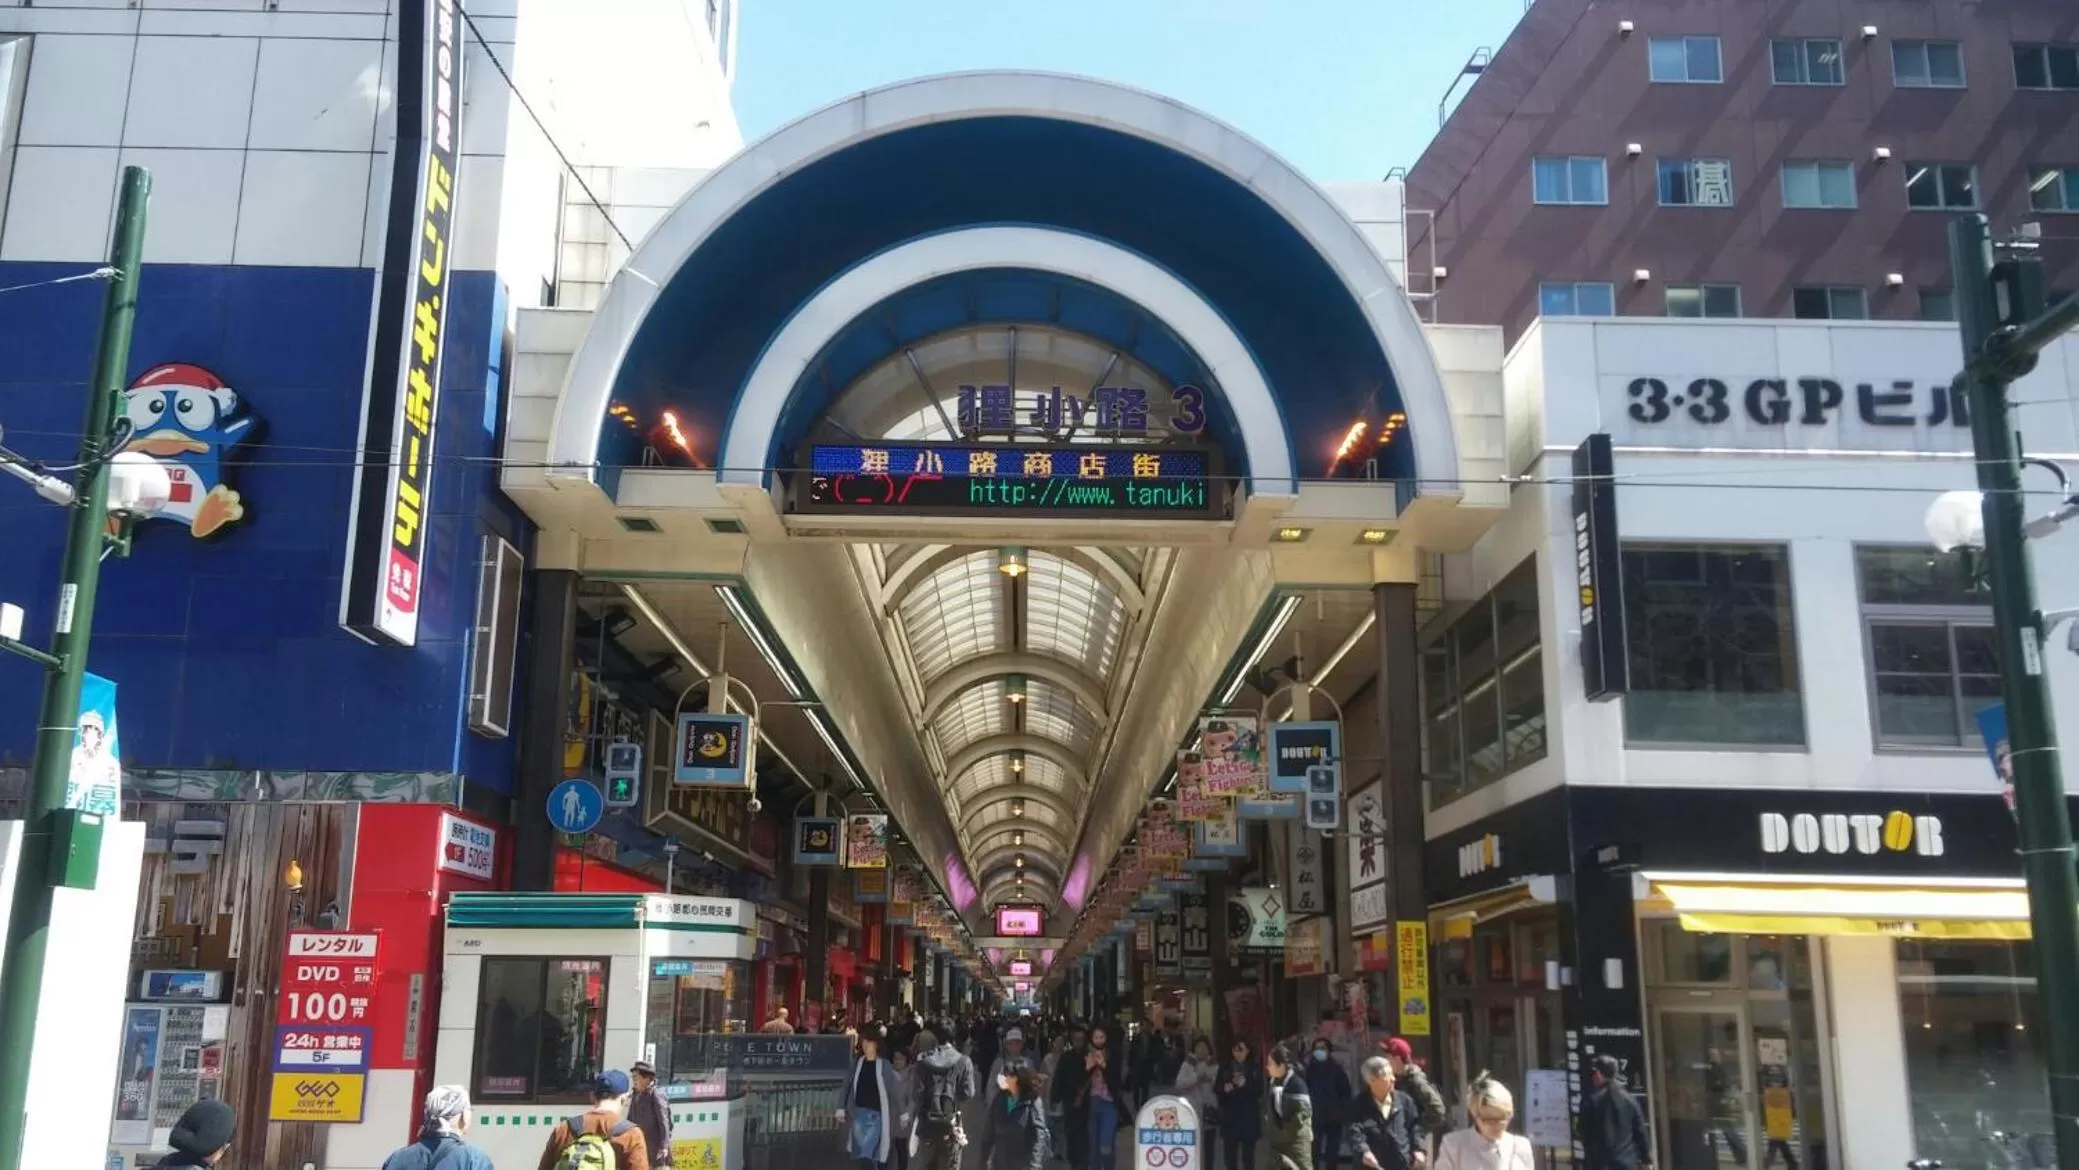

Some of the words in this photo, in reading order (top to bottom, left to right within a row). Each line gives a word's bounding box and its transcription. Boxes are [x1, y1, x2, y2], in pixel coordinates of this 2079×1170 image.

[957, 385, 1148, 433] 狸小路
[1170, 385, 1205, 433] 3
[860, 447, 1161, 479] 狸小路商店街
[1760, 810, 1944, 857] DOUTOR
[302, 937, 364, 952] レンタル
[297, 966, 340, 981] DVD
[288, 992, 347, 1020] 100
[284, 1033, 319, 1048] 24h
[323, 1035, 361, 1049] 営業中
[766, 1040, 813, 1053] TOWN
[312, 1051, 331, 1063] 5F
